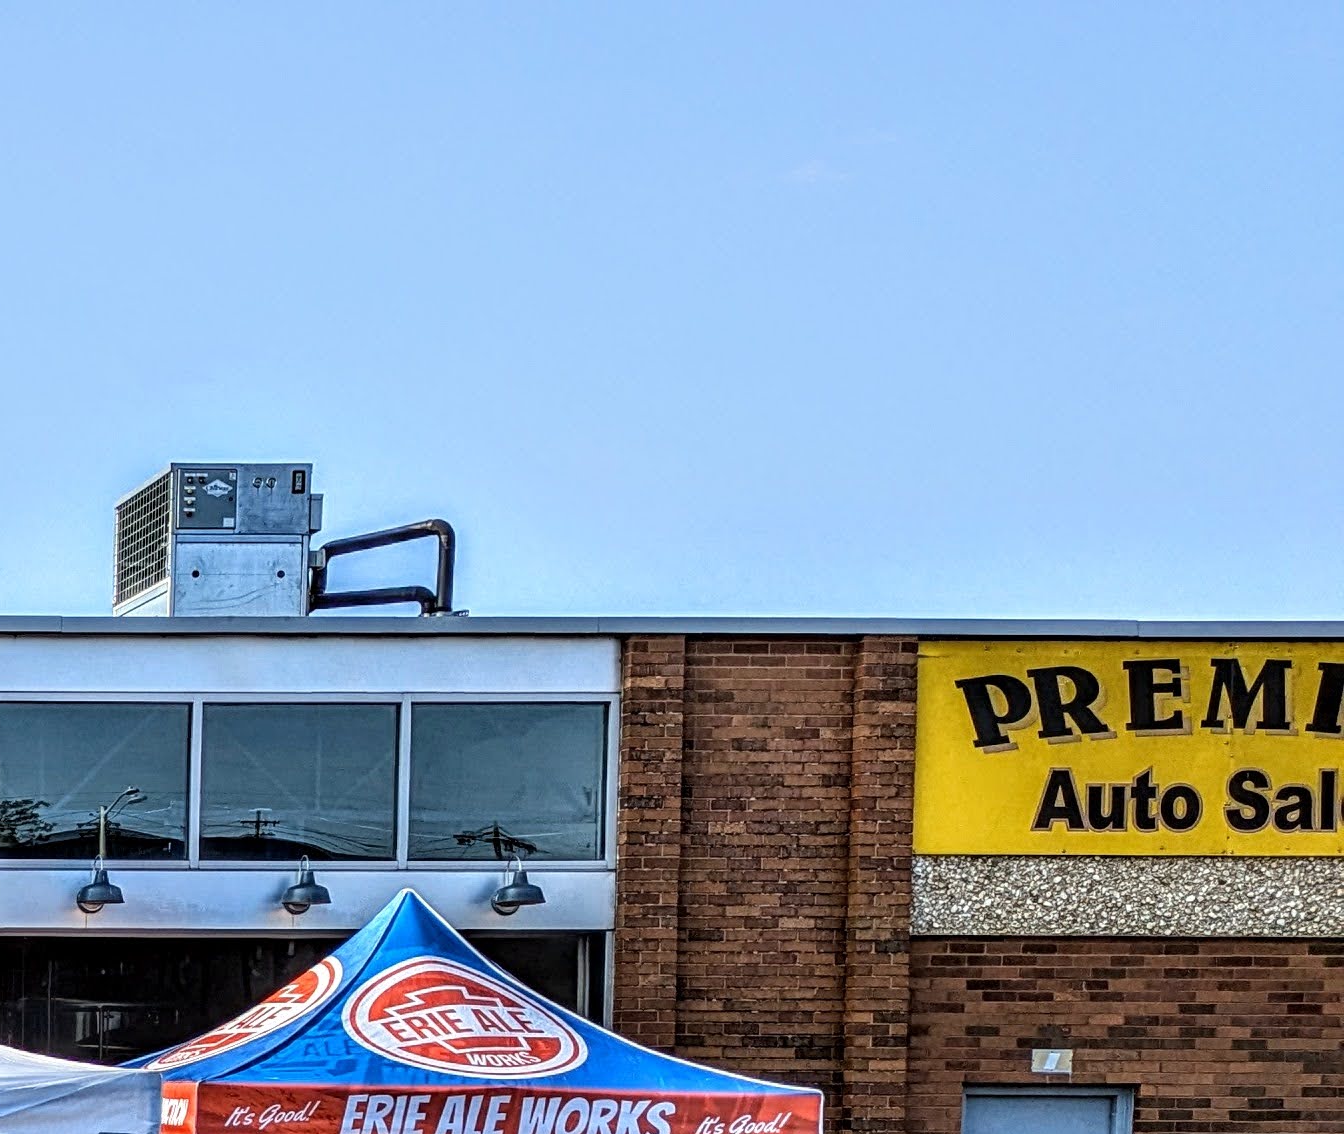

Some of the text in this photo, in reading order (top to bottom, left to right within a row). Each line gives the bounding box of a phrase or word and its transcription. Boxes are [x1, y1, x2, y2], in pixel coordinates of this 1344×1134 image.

[1030, 765, 1344, 833] Auto Sal
[381, 1008, 545, 1043] ERIE ALE
[466, 1051, 542, 1068] WORKS
[224, 1105, 254, 1128] It's
[258, 1100, 321, 1130] Good!
